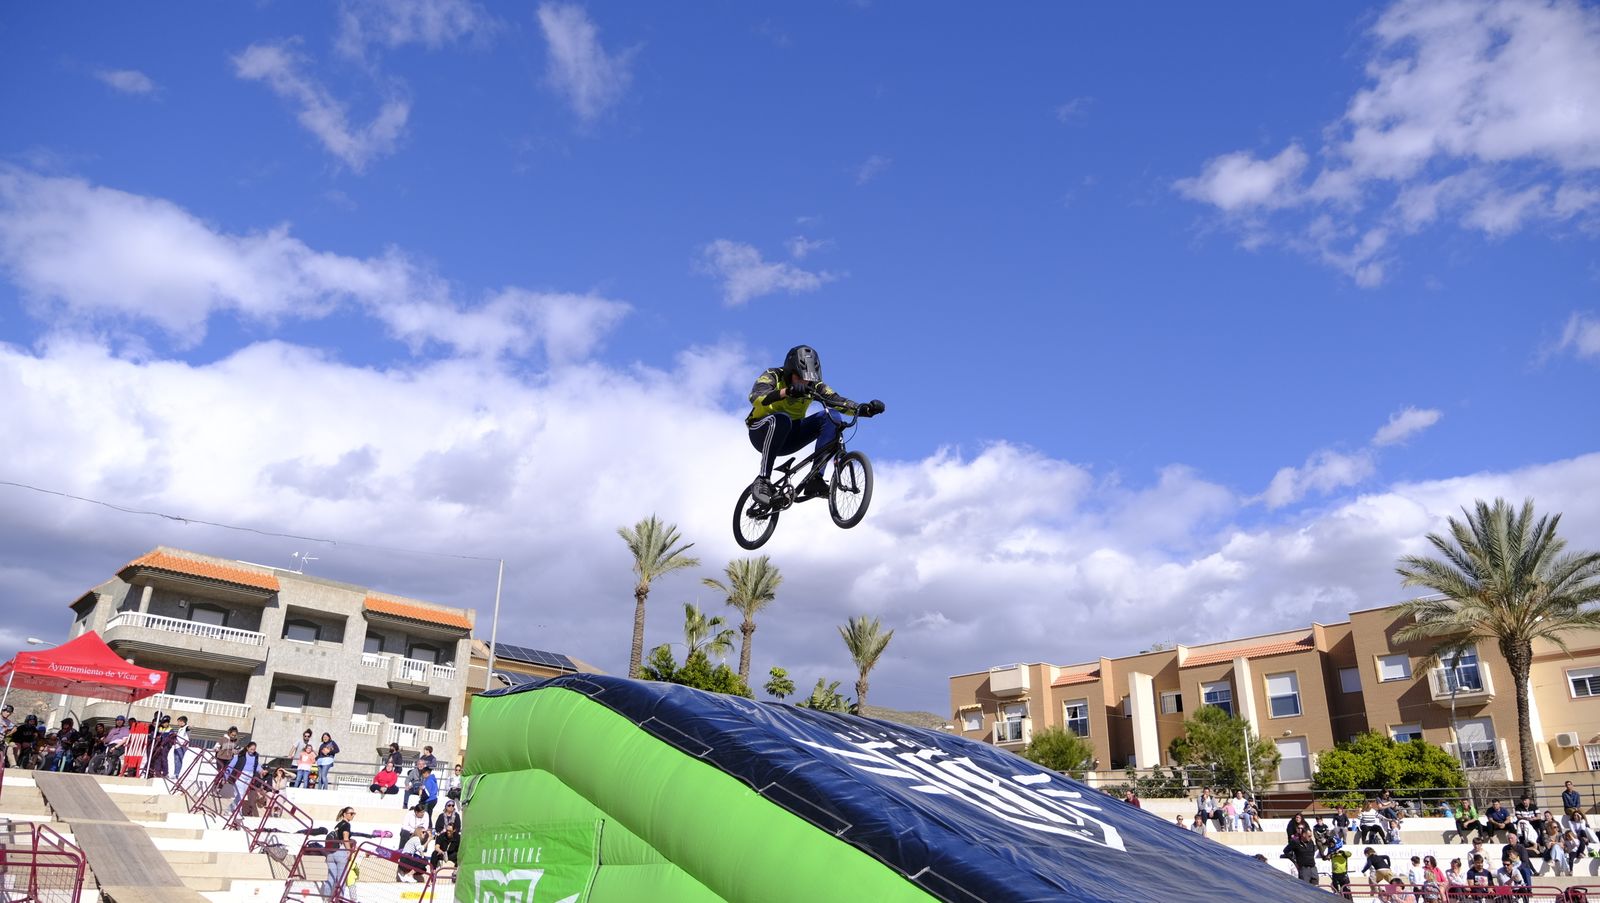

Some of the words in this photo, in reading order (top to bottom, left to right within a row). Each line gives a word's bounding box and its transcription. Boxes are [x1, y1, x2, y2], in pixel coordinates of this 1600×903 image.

[48, 662, 104, 676] Ayuntamiento
[105, 670, 115, 678] de
[117, 671, 138, 680] Vícar
